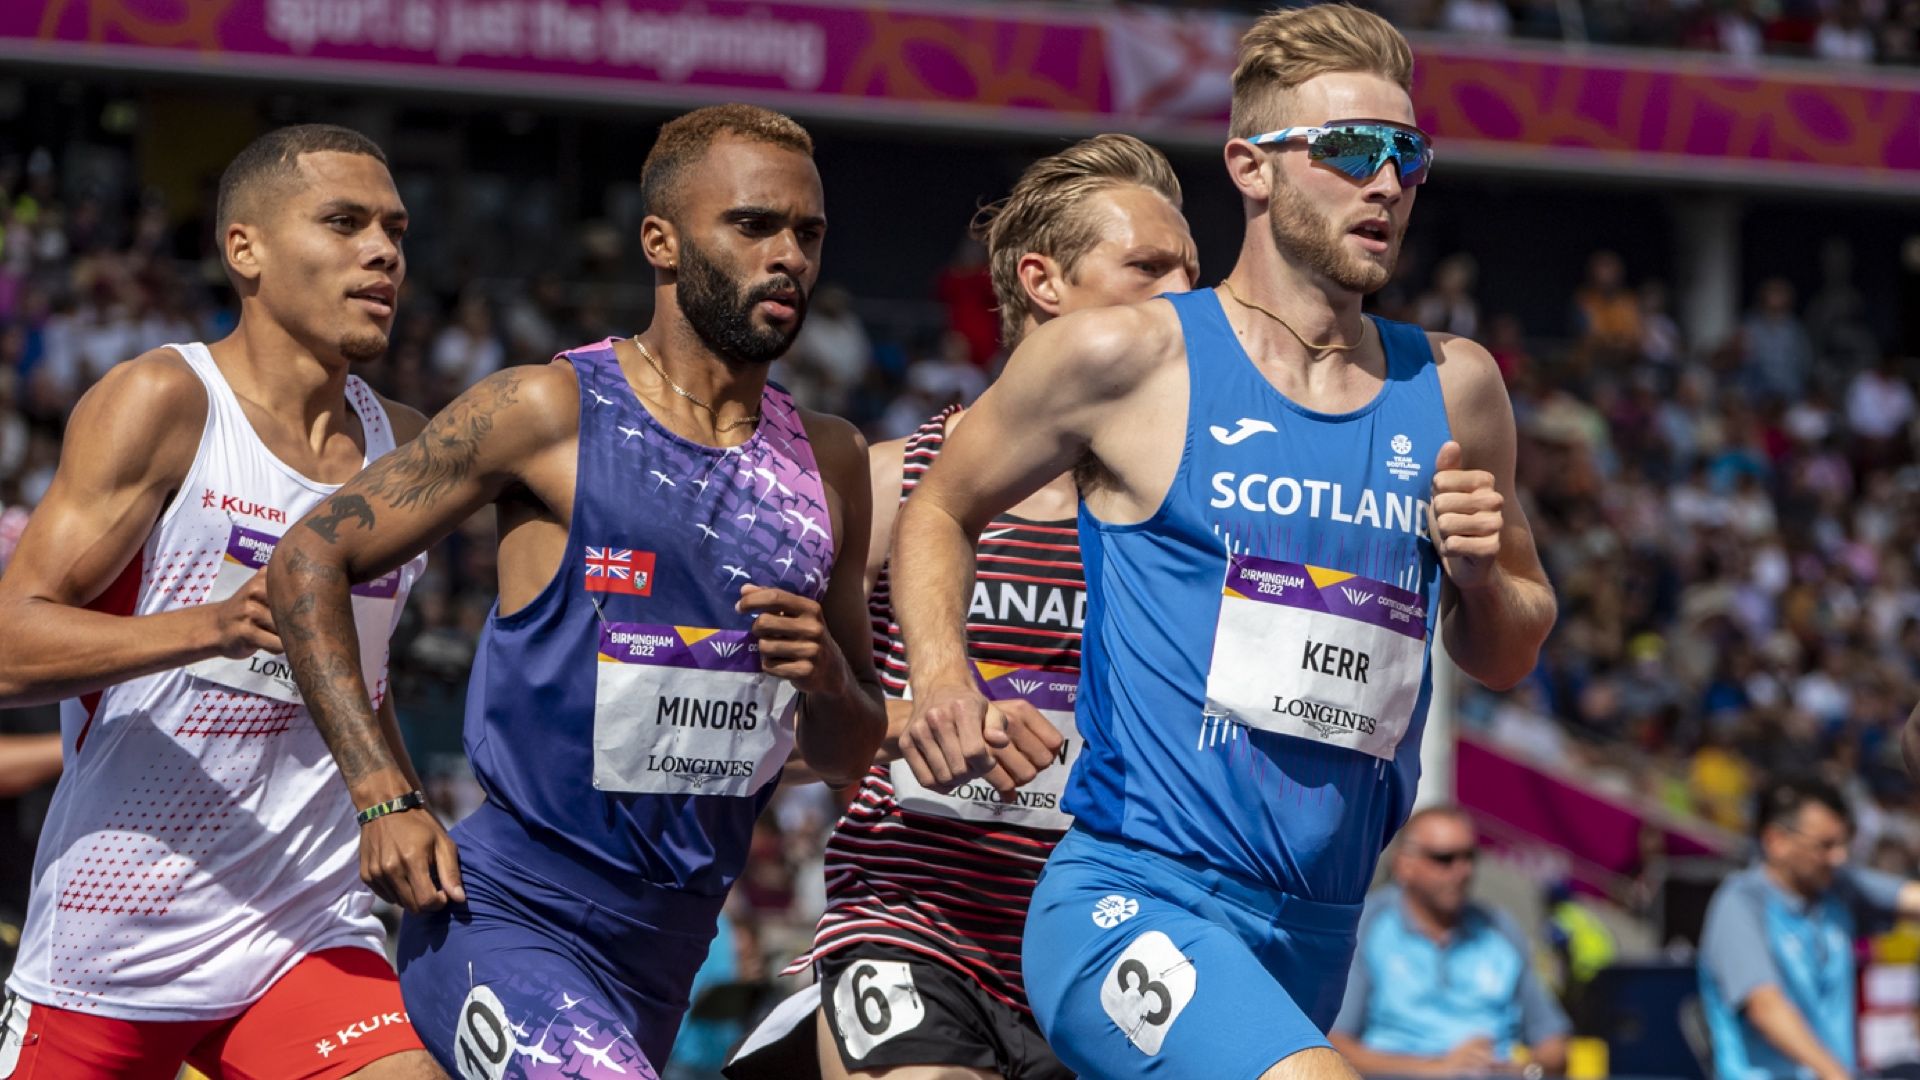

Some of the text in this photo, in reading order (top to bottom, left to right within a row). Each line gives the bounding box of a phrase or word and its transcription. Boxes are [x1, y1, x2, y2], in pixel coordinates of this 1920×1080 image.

[437, 0, 524, 63] just
[530, 0, 597, 63] the
[603, 2, 824, 91] beginning
[221, 495, 287, 525] KUKRI
[1211, 472, 1431, 542] SCOTLAND
[1240, 568, 1304, 589] BIRMINGHAM
[1257, 582, 1284, 597] 2022
[611, 632, 674, 648] BIRMINGHAM
[629, 644, 655, 657] 2022
[1301, 639, 1370, 684] KERR
[656, 696, 758, 730] MINORS
[1272, 696, 1377, 735] LONGINES
[647, 755, 754, 777] LONGINES
[852, 963, 892, 1036] 6
[1117, 958, 1172, 1027] 3
[459, 1001, 508, 1080] 10
